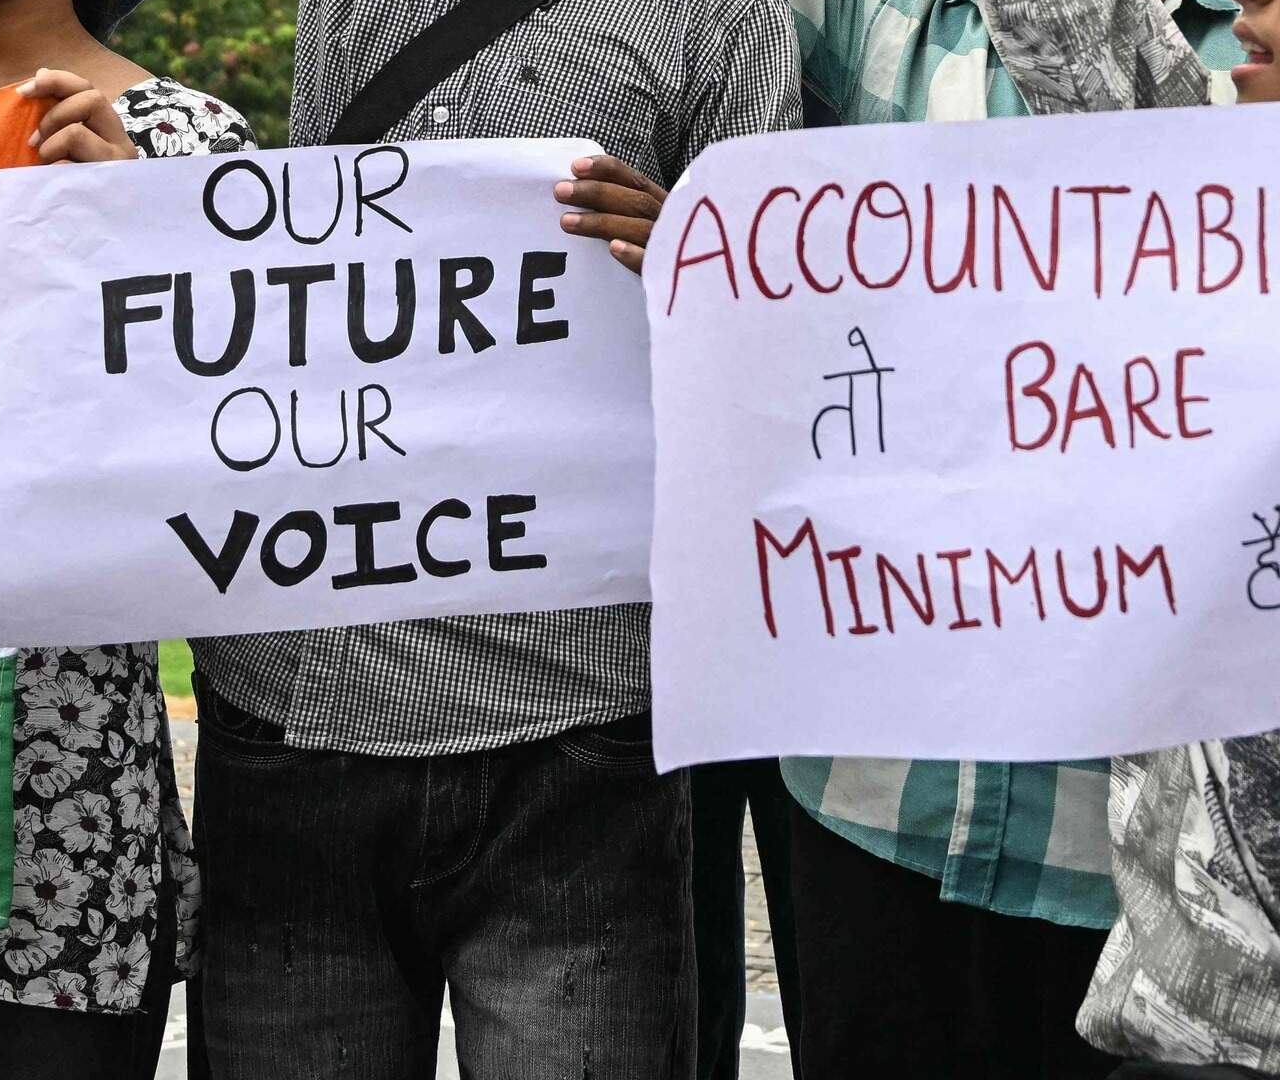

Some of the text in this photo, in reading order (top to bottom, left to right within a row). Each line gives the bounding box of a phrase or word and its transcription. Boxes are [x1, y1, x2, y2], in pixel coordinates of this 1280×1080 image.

[202, 144, 414, 246] OUR
[100, 250, 571, 378] FUTURE
[209, 382, 408, 473] OUR
[810, 325, 1214, 461] तो BARE
[164, 493, 549, 596] VOICE
[752, 516, 1178, 640] MINIMUM
